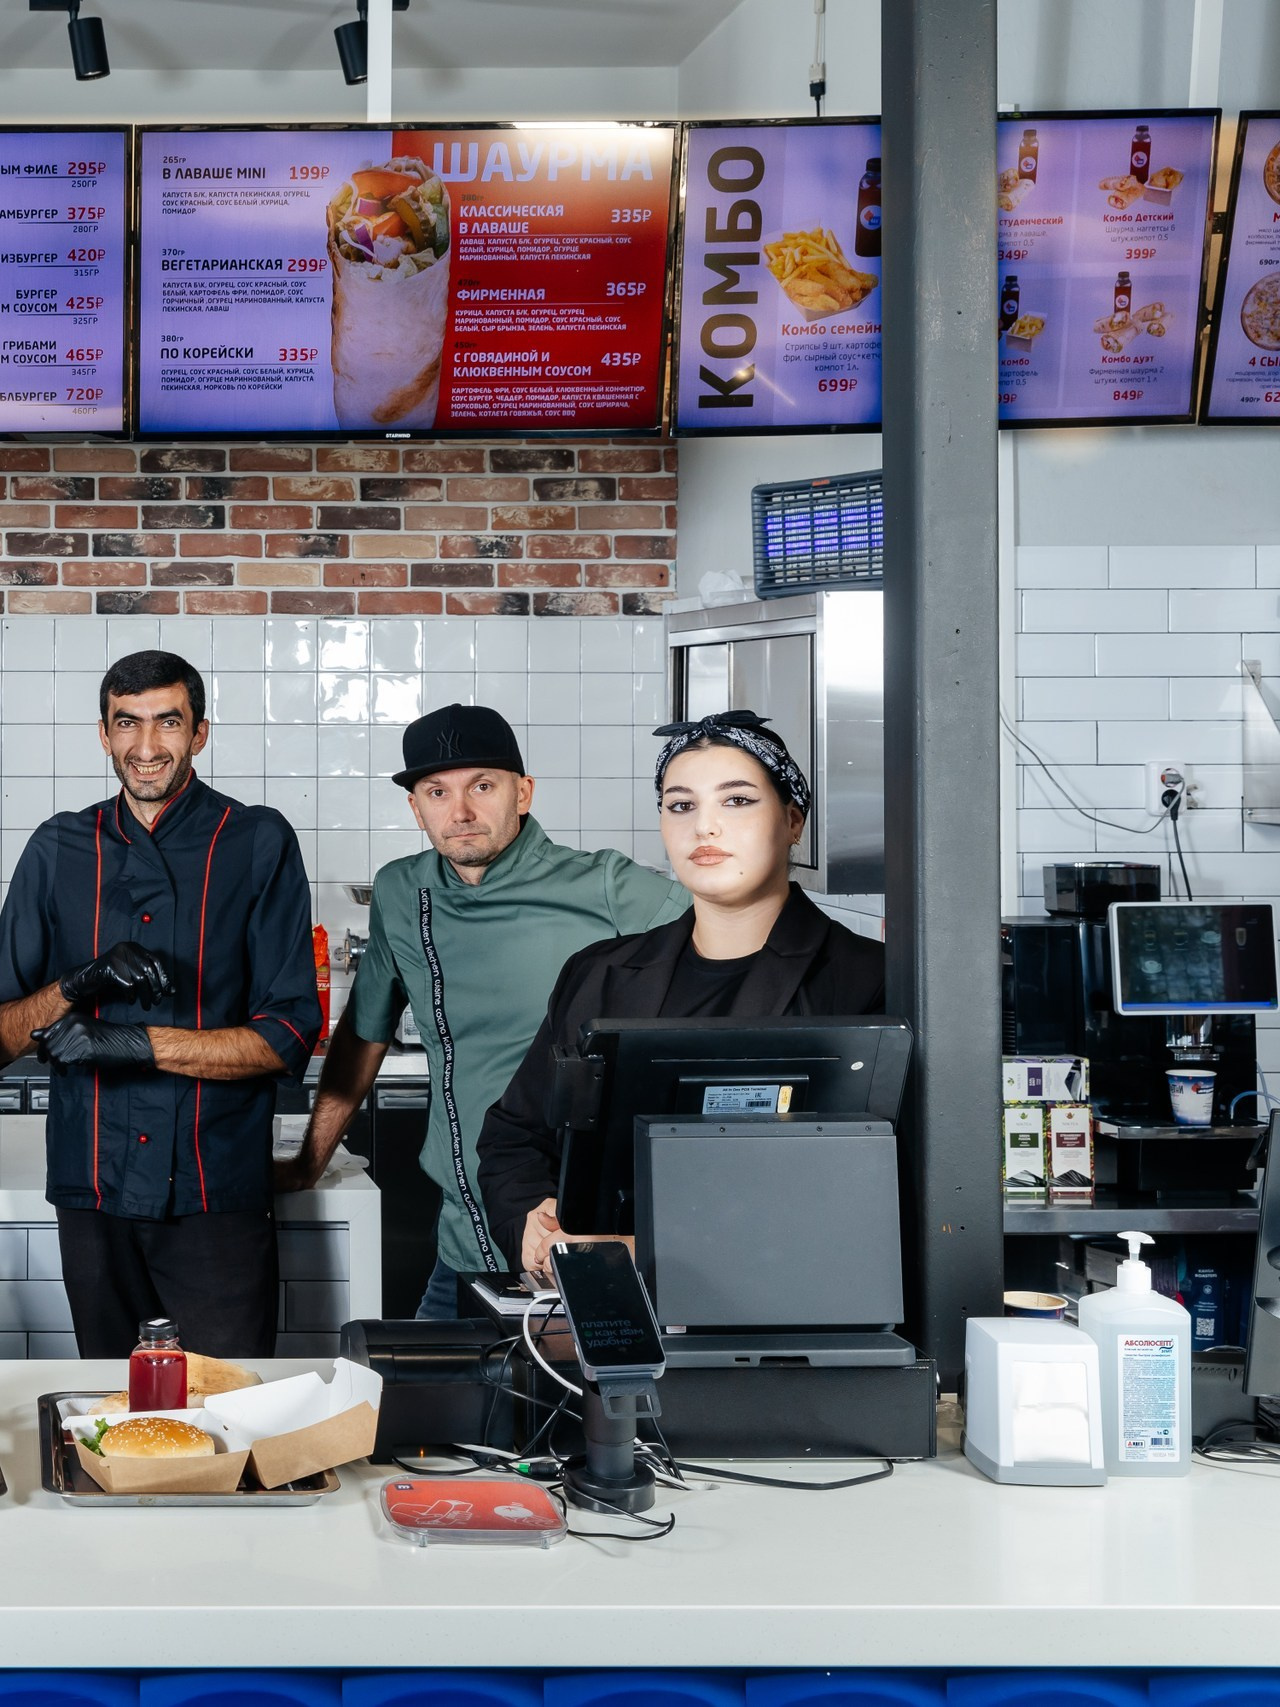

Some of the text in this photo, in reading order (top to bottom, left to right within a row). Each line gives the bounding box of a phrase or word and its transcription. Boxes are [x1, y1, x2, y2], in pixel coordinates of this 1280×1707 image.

[433, 142, 654, 183] ШАУРМА
[24, 164, 58, 174] ФИЛЕ
[162, 168, 171, 179] В
[175, 167, 232, 179] ЛАВАШЕ
[237, 167, 266, 179] MINI
[71, 180, 97, 188] 250ГР
[460, 205, 564, 217] КЛАССИЧЕСКАЯ
[999, 217, 1063, 227] студенческий
[1103, 212, 1174, 223] Комбо Детский
[459, 222, 529, 234] В ЛАВАШЕ
[161, 259, 283, 271] ВЕГЕТАРИАНСКАЯ
[698, 146, 765, 408] КОМБО
[16, 290, 57, 299] БУРГЕР
[456, 288, 545, 301] ФИРМЕННАЯ
[13, 303, 57, 312] СОУСОМ
[782, 324, 827, 336] Комбо
[2, 341, 57, 350] ГРИБАМИ
[160, 348, 179, 359] ПО
[183, 345, 254, 359] КОРЕЙСКИ
[454, 353, 460, 363] С
[464, 350, 538, 364] ГОВЯДИНОЙ
[542, 352, 550, 362] И
[13, 354, 57, 363] СОУСОМ
[1001, 358, 1029, 366] комбо
[1101, 355, 1154, 364] Комбо дуэт
[453, 366, 592, 377] КЛЮКВЕННЫМ СОУСОМ
[815, 364, 844, 372] компот
[203, 383, 236, 391] МОРКОВЬ
[247, 382, 283, 390] КОРЕЙСКИ
[581, 1320, 631, 1328] платите
[586, 1337, 632, 1348] удобно
